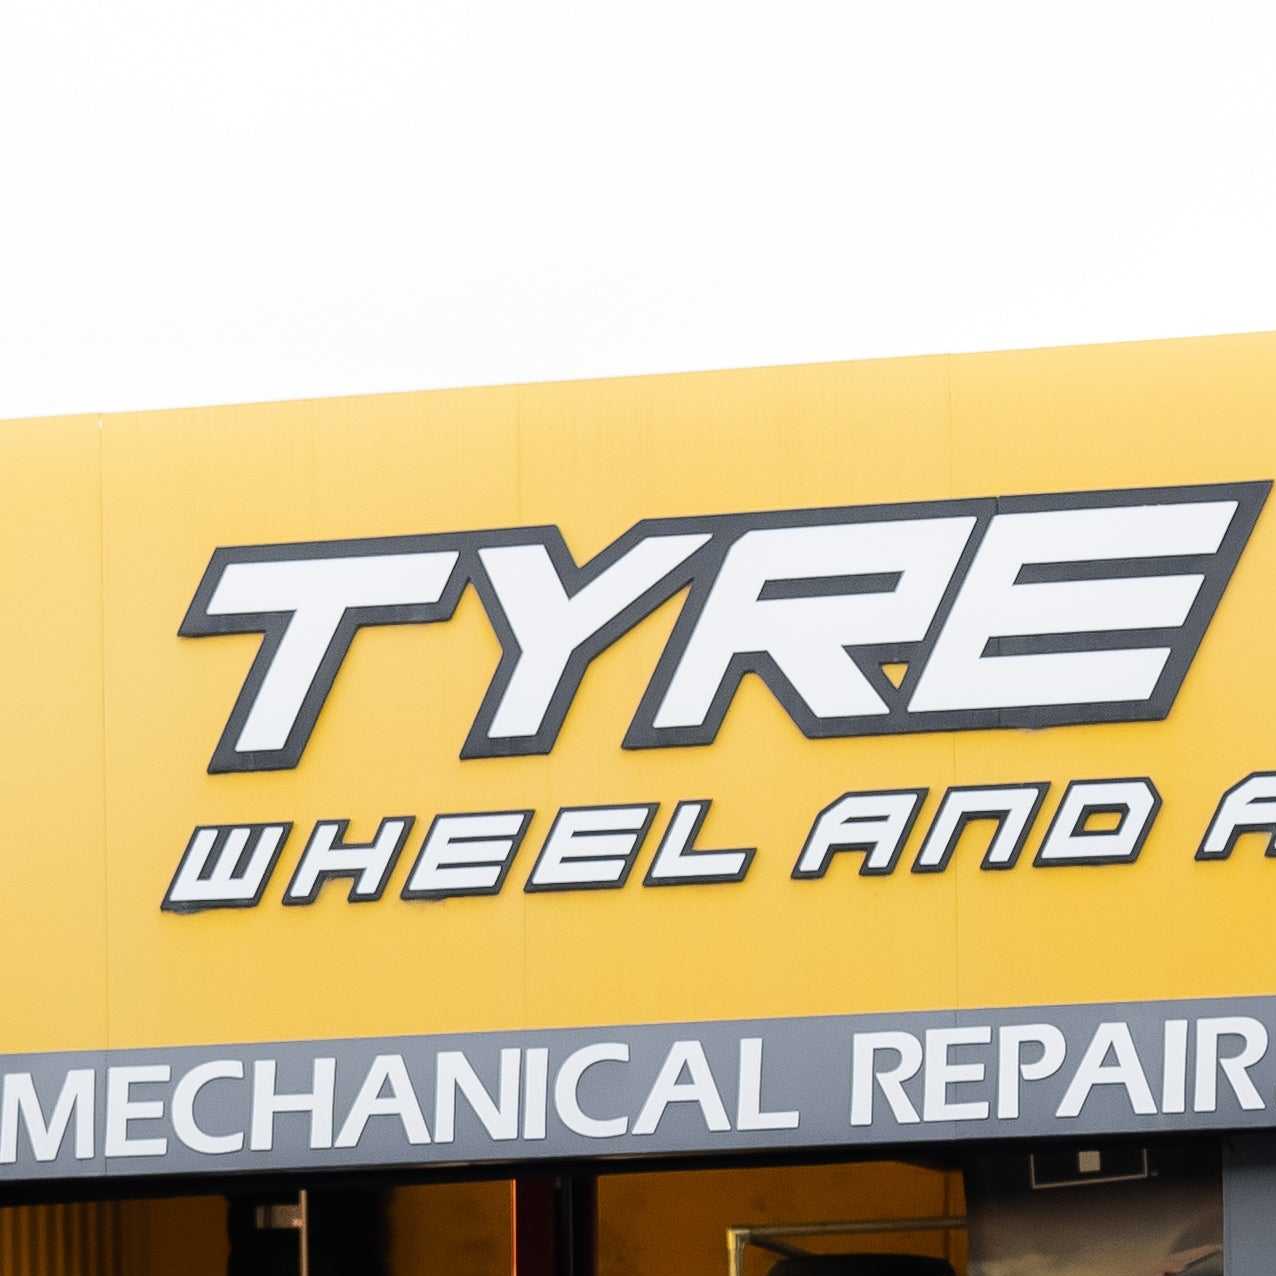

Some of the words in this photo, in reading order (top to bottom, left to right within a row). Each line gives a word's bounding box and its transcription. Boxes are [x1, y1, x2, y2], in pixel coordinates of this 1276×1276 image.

[177, 480, 1274, 775] TYRE
[160, 799, 757, 915] WHEEL
[791, 777, 1163, 880] AND
[0, 1037, 799, 1164] MECHANICAL
